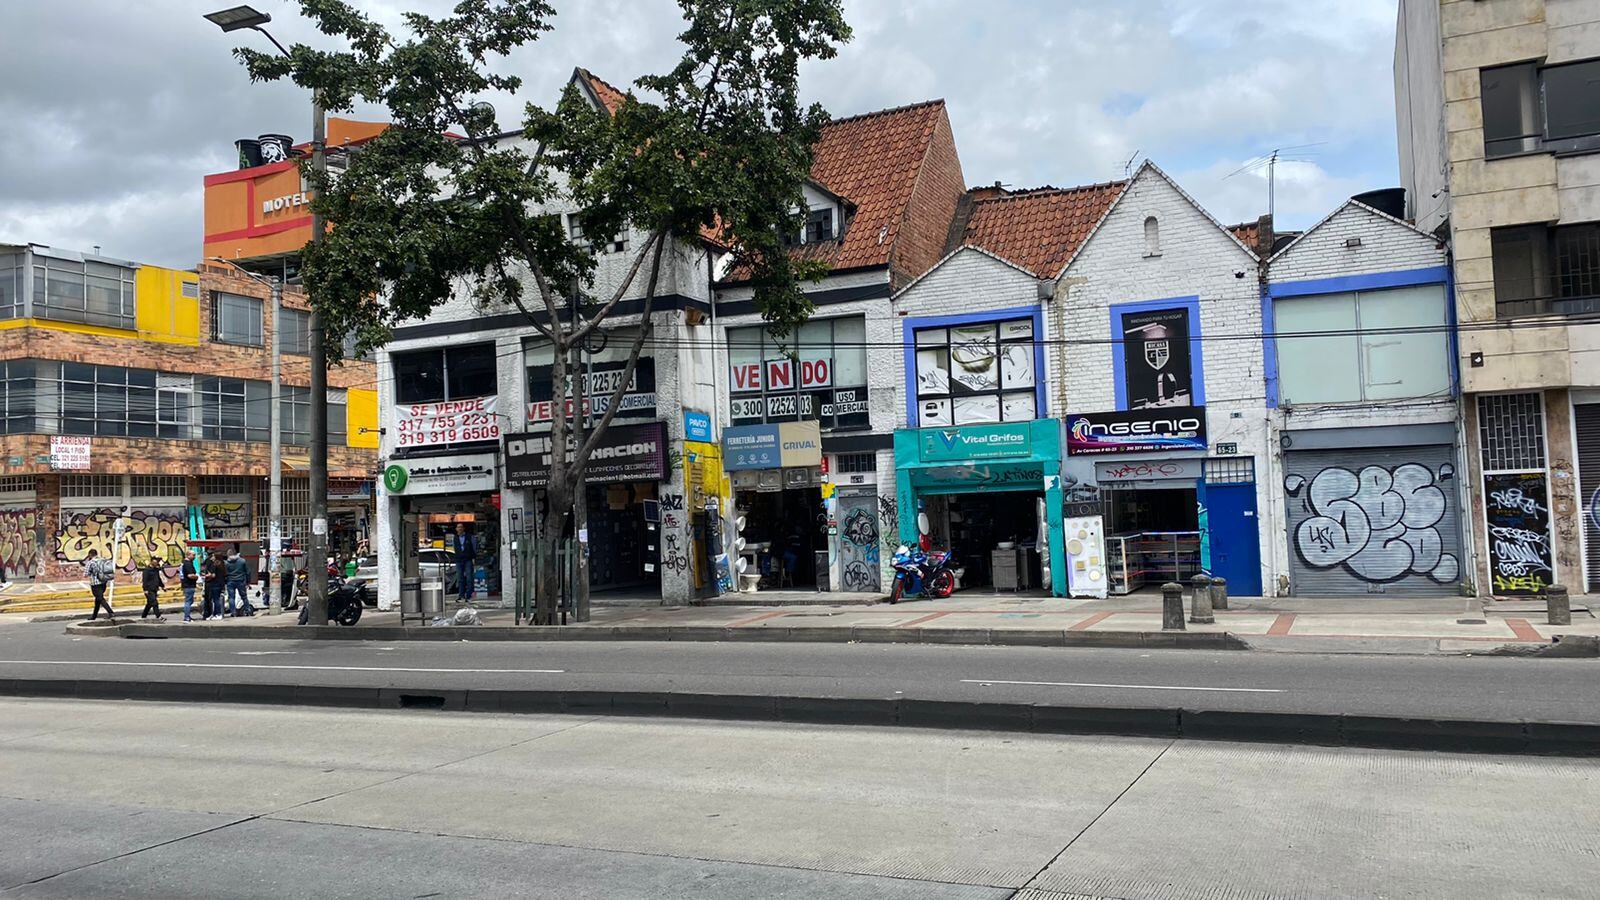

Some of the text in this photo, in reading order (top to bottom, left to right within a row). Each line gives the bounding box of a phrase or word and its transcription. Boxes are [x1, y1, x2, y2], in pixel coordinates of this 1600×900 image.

[263, 193, 310, 213] MOTEL
[593, 373, 610, 392] 225
[838, 392, 854, 402] USO
[410, 400, 485, 417] SE VENDE
[744, 400, 763, 416] 300
[823, 401, 868, 414] COMERCIAL
[399, 418, 423, 432] 317
[430, 416, 456, 429] 755
[51, 436, 90, 446] SE ARRIENDA
[399, 425, 499, 445] 319 319 6509
[962, 435, 988, 444] Vital
[989, 434, 1025, 443] Grifos
[783, 440, 817, 450] GRIVAL
